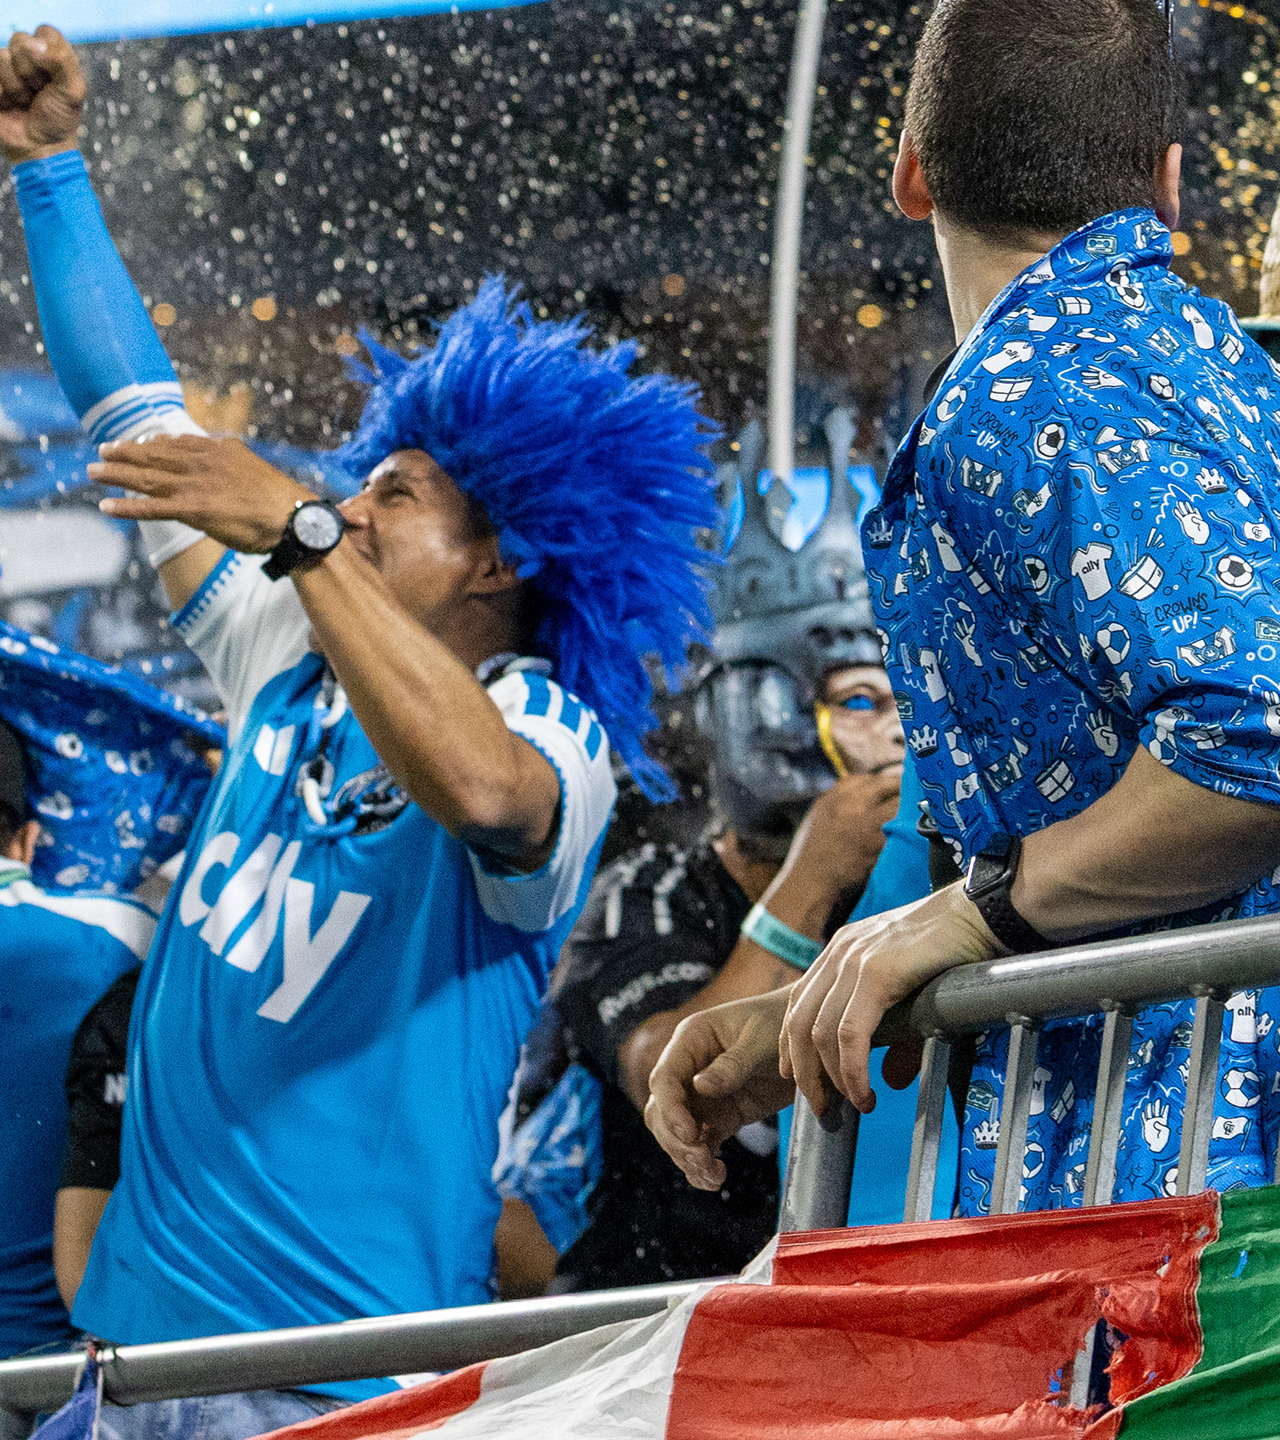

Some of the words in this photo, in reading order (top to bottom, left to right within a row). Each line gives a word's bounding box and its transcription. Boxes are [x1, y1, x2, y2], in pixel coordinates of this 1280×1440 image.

[977, 411, 1019, 448] CROWNS
[976, 430, 1001, 452] UP!
[1081, 559, 1100, 575] ally
[1154, 592, 1208, 620] CROWNS
[1172, 612, 1199, 633] UP!
